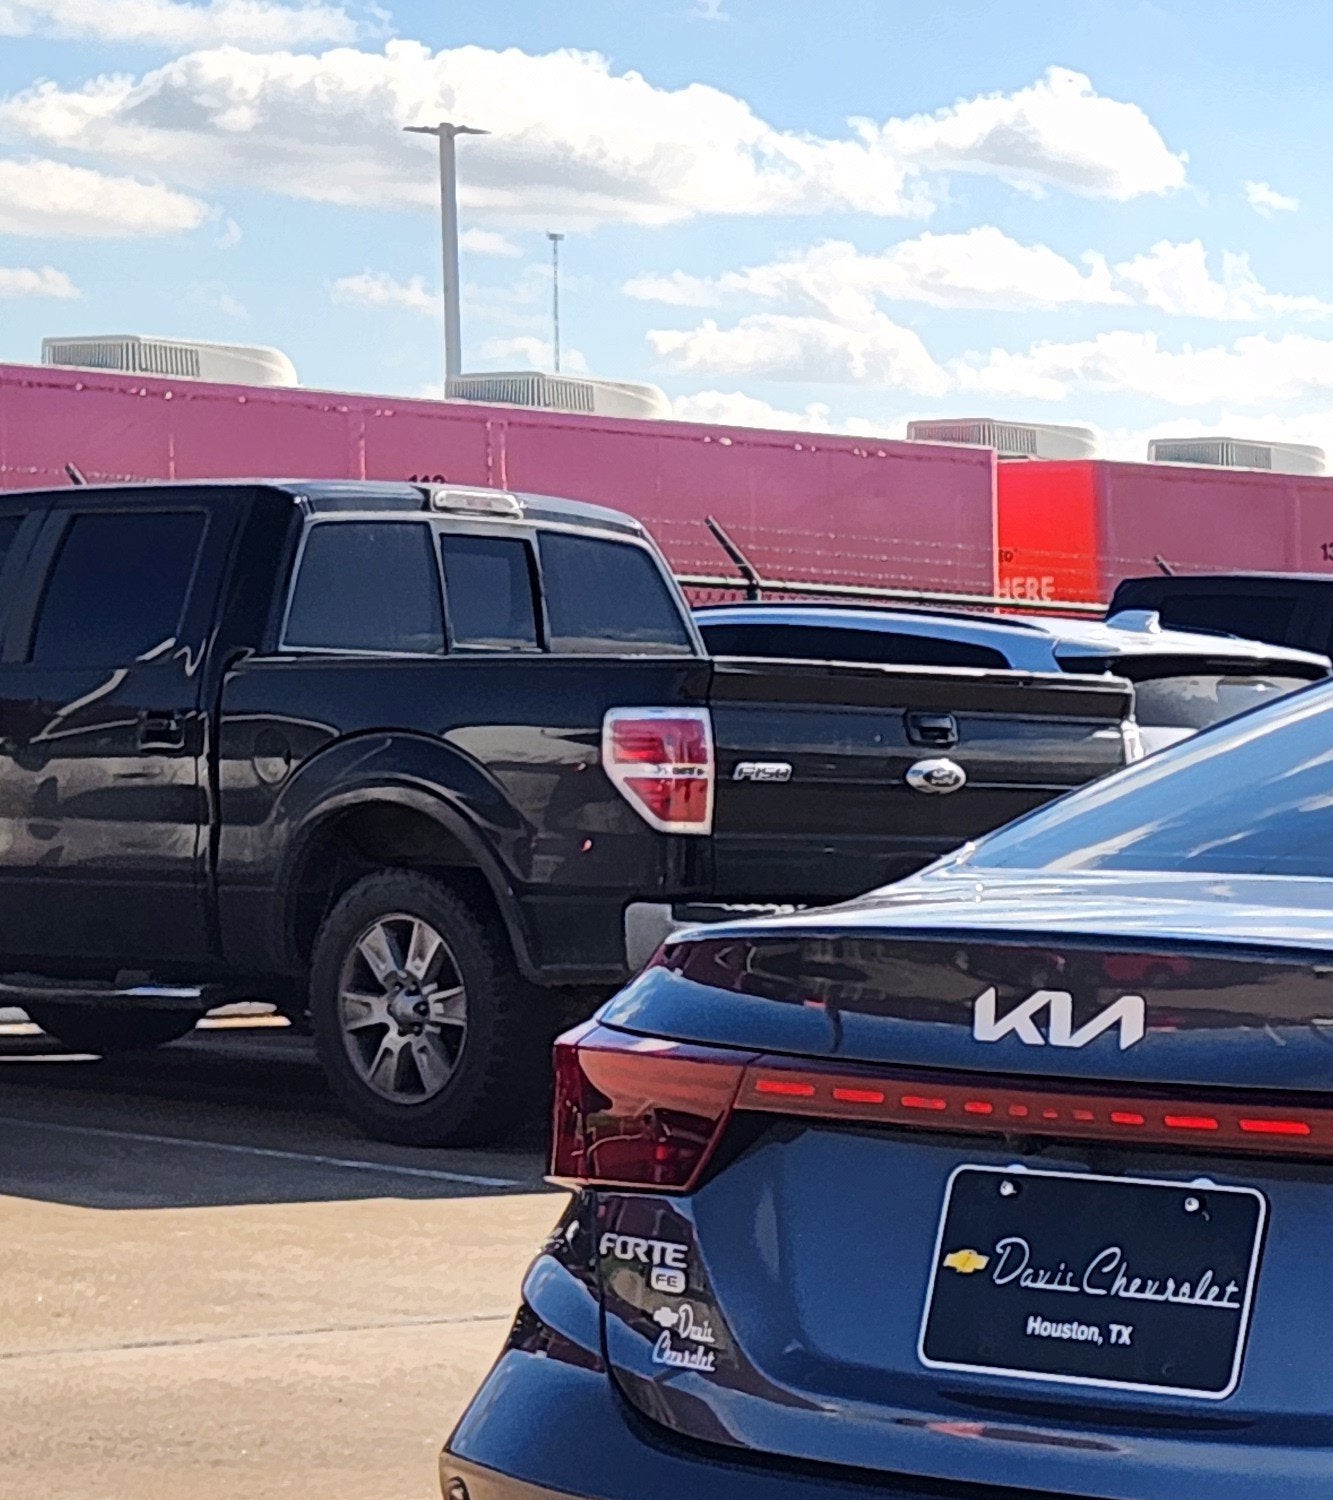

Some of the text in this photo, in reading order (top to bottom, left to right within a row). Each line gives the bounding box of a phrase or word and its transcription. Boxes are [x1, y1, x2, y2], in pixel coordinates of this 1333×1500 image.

[974, 987, 1145, 1050] KIA
[600, 1232, 688, 1268] FORTE
[656, 1274, 678, 1288] FE
[992, 1236, 1240, 1308] Davis Chevrolet
[1026, 1316, 1134, 1346] Houston, TX
